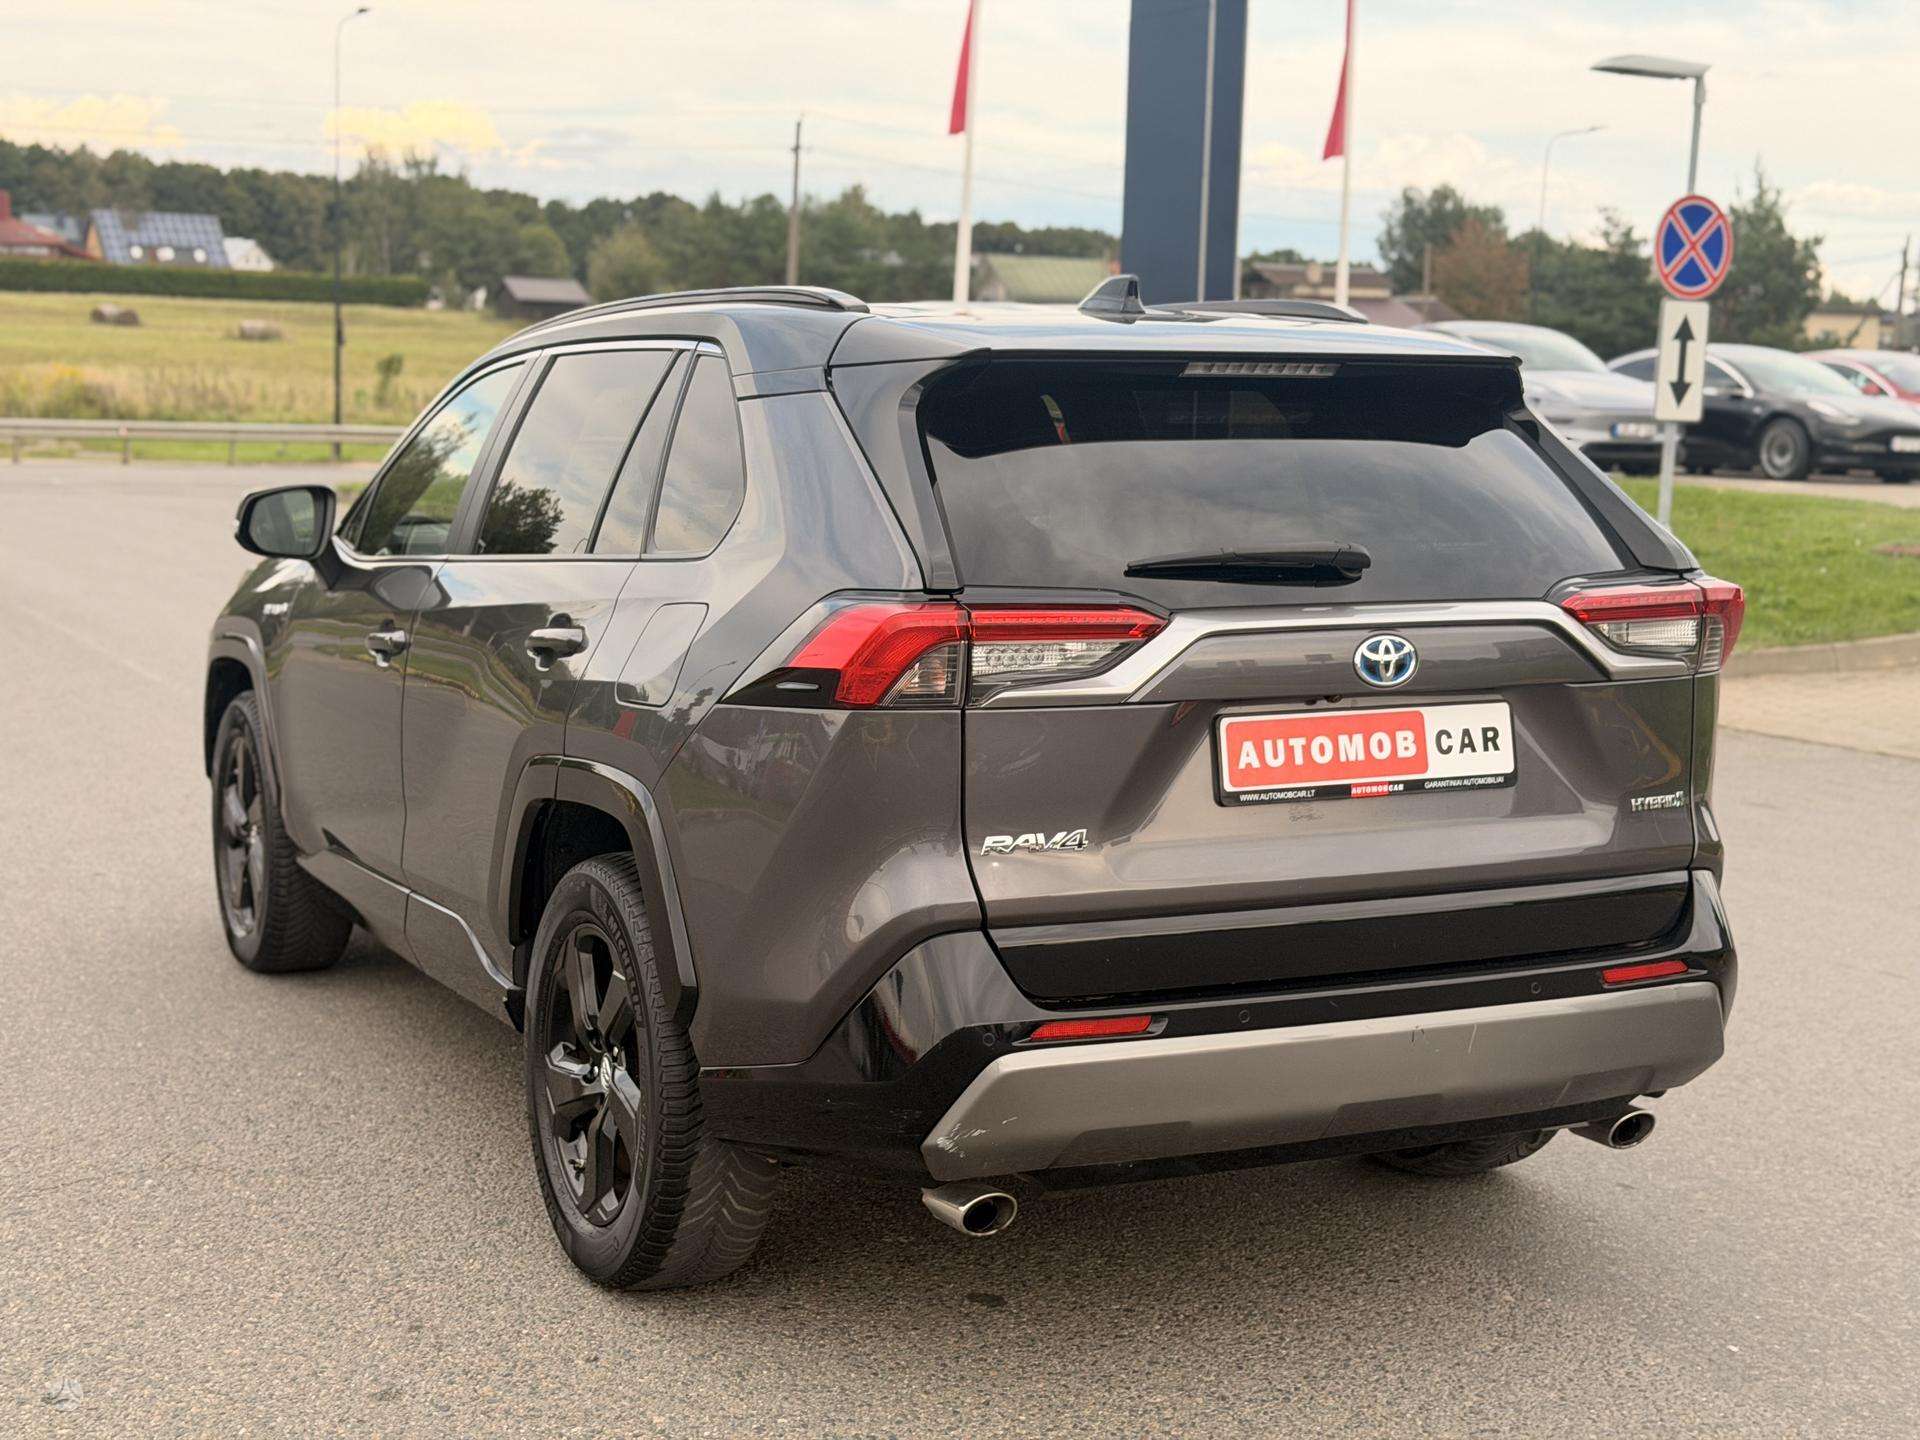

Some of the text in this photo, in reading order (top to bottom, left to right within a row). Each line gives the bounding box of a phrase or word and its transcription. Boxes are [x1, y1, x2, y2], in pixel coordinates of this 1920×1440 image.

[1238, 726, 1500, 769] AUTOMOB CAR
[1240, 789, 1316, 801] WWW.AUTOMOBCAR.LT
[980, 829, 1089, 857] RAV4
